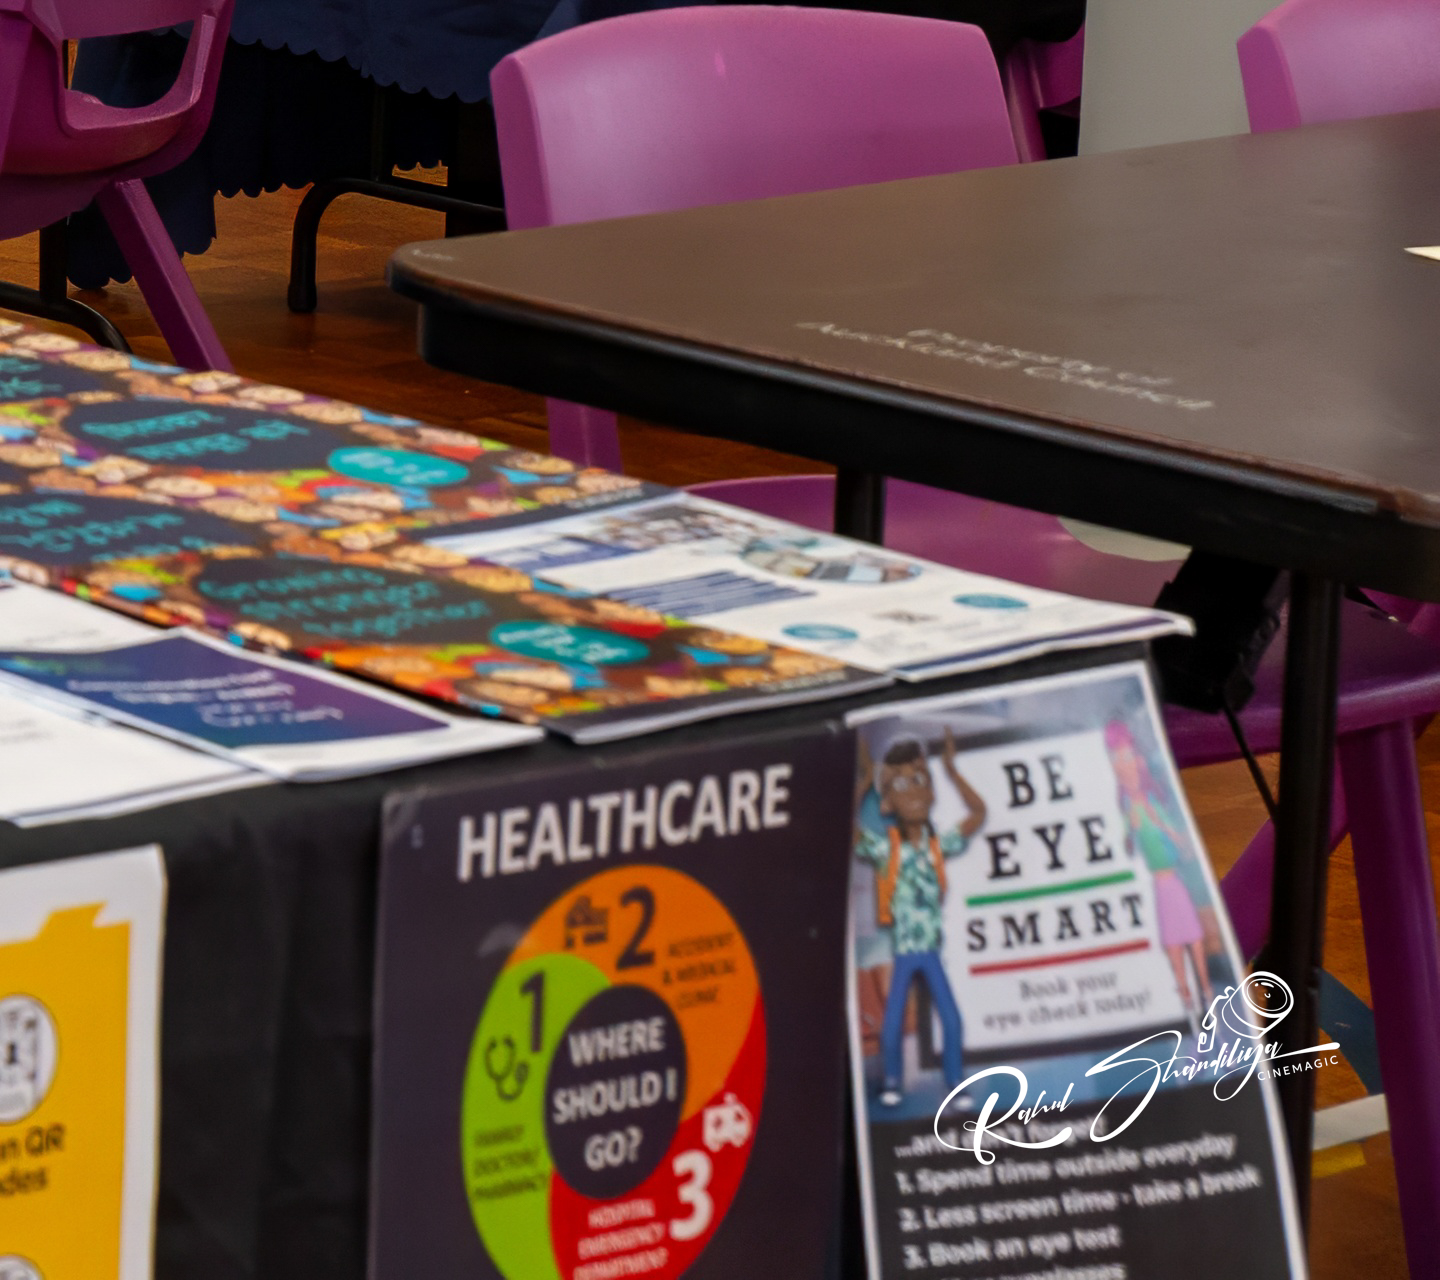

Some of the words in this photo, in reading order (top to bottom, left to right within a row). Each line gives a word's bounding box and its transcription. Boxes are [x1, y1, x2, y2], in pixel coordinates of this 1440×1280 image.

[1003, 752, 1074, 811] BE
[457, 764, 793, 882] HEALTHCARE
[985, 815, 1114, 881] EYE
[615, 886, 657, 972] 2
[967, 893, 1146, 953] SMART
[519, 970, 547, 1053] 1
[982, 1010, 1024, 1032] eye
[1028, 999, 1089, 1028] check
[1019, 976, 1071, 1002] Book
[1075, 971, 1120, 997] your
[568, 1016, 666, 1067] WHERE
[553, 1072, 661, 1124] SHOULD
[666, 1067, 678, 1101] I
[24, 1122, 66, 1158] QR
[584, 1127, 643, 1171] GO?
[917, 1159, 994, 1199] Spend
[998, 1153, 1051, 1185] time
[1056, 1142, 1145, 1179] outside
[1146, 1131, 1238, 1173] everyday
[668, 1149, 714, 1243] 3
[924, 1199, 977, 1231] Less
[982, 1192, 1060, 1225] screen
[1063, 1184, 1117, 1214] time
[1136, 1179, 1183, 1209] take
[1206, 1170, 1262, 1198] break
[929, 1231, 994, 1268] Book
[997, 1235, 1026, 1258] an
[1031, 1233, 1072, 1260] eye
